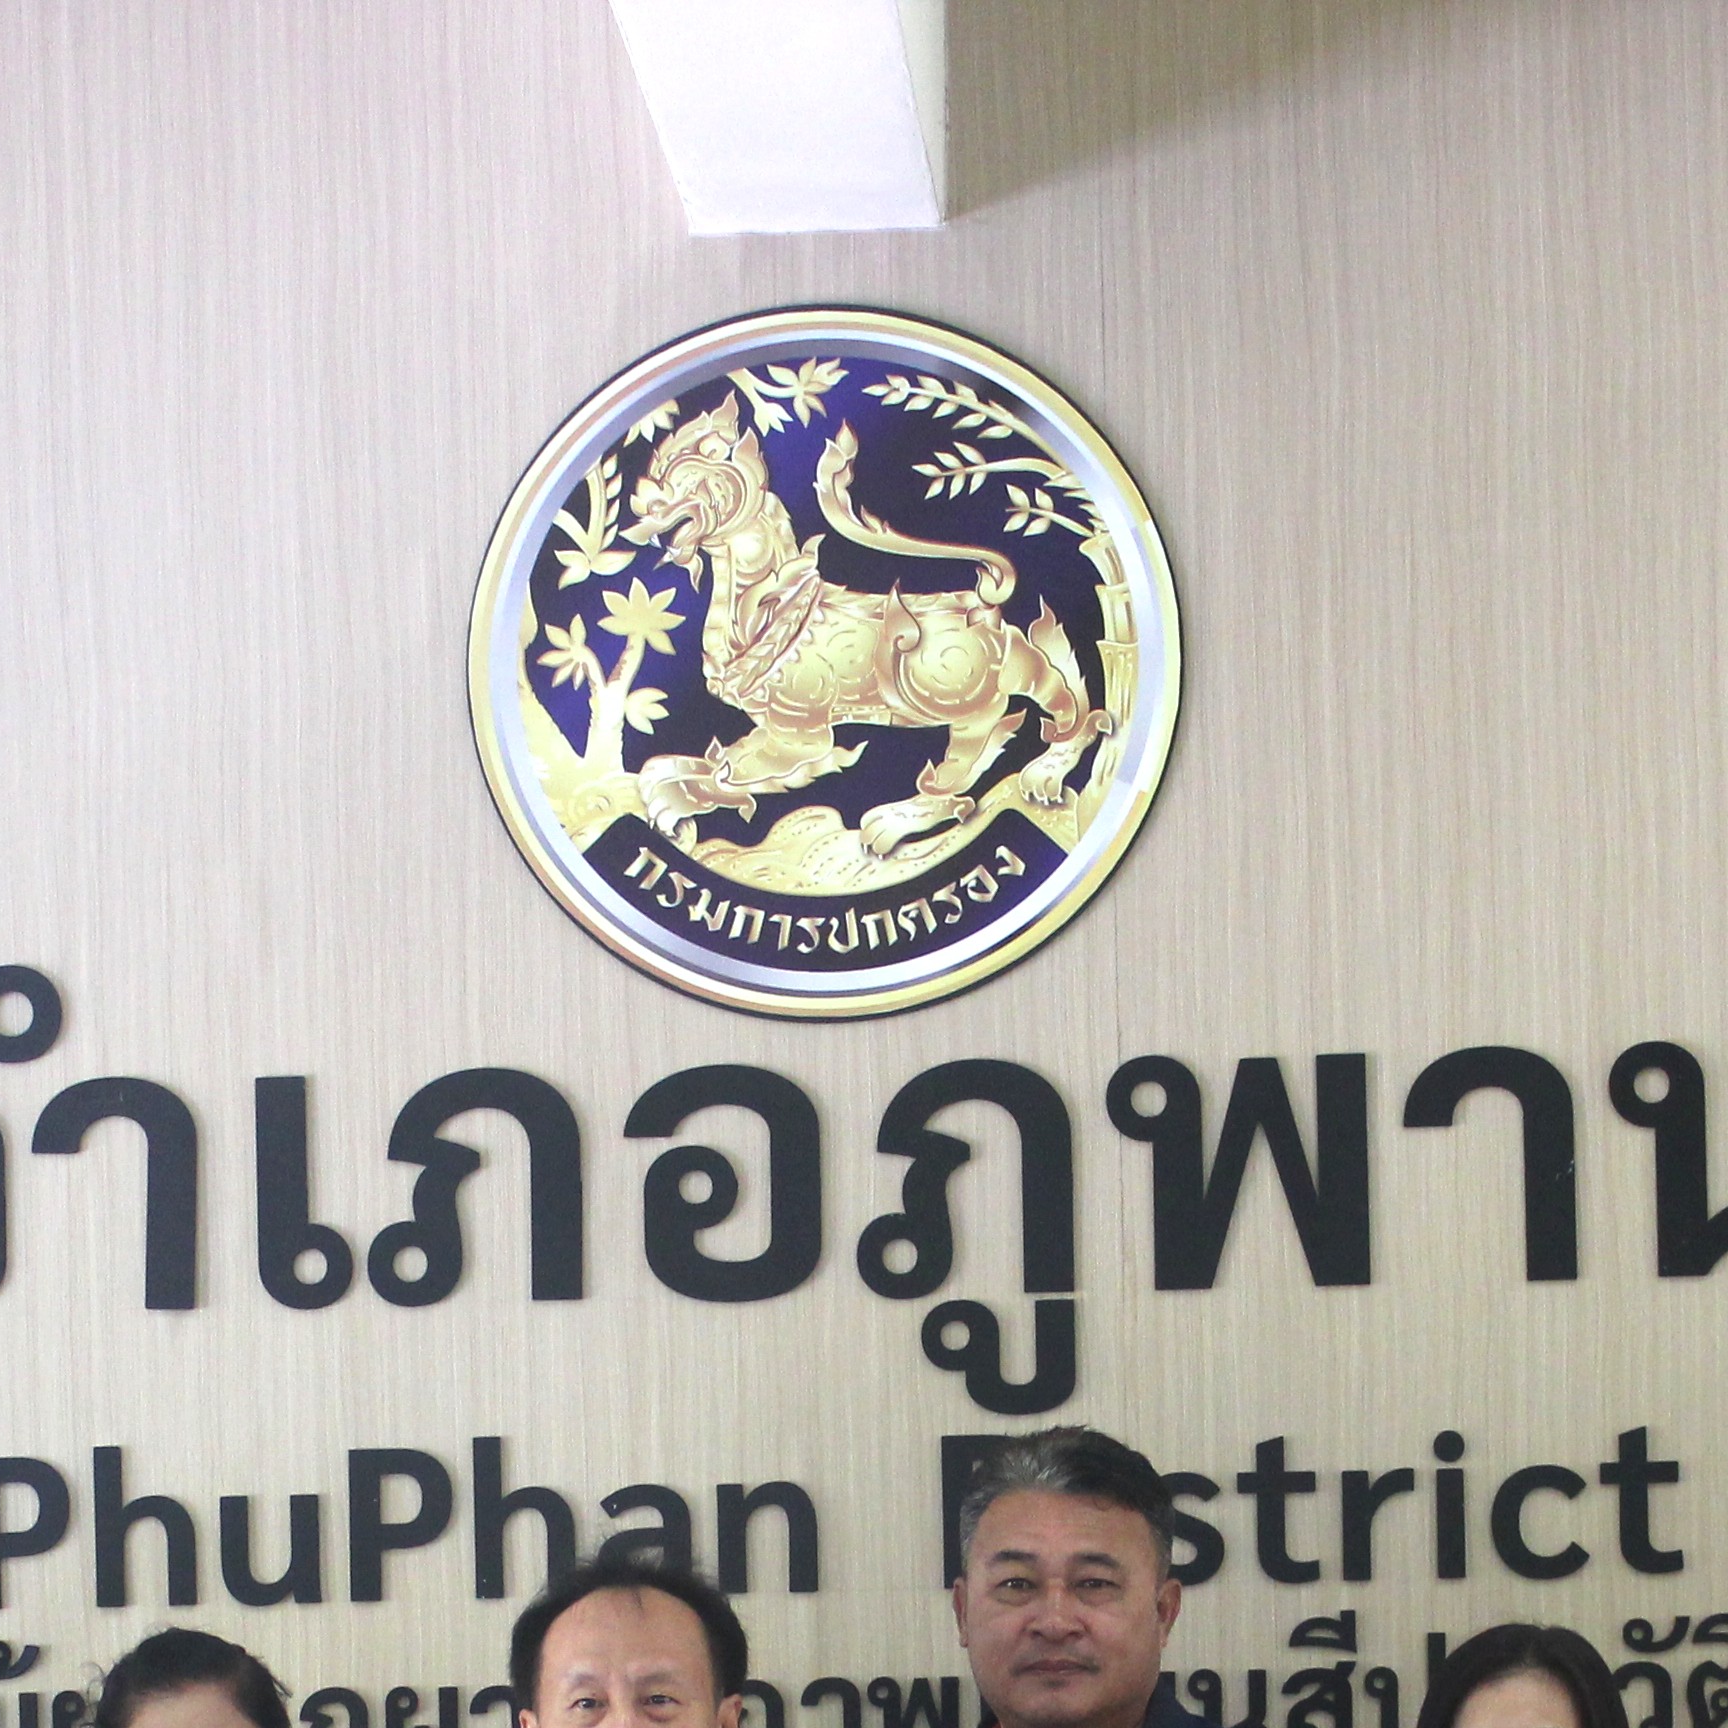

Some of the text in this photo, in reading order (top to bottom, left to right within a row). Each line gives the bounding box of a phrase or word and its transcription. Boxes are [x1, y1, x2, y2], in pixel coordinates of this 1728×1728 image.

[623, 845, 1026, 954] กรมการปกครอง
